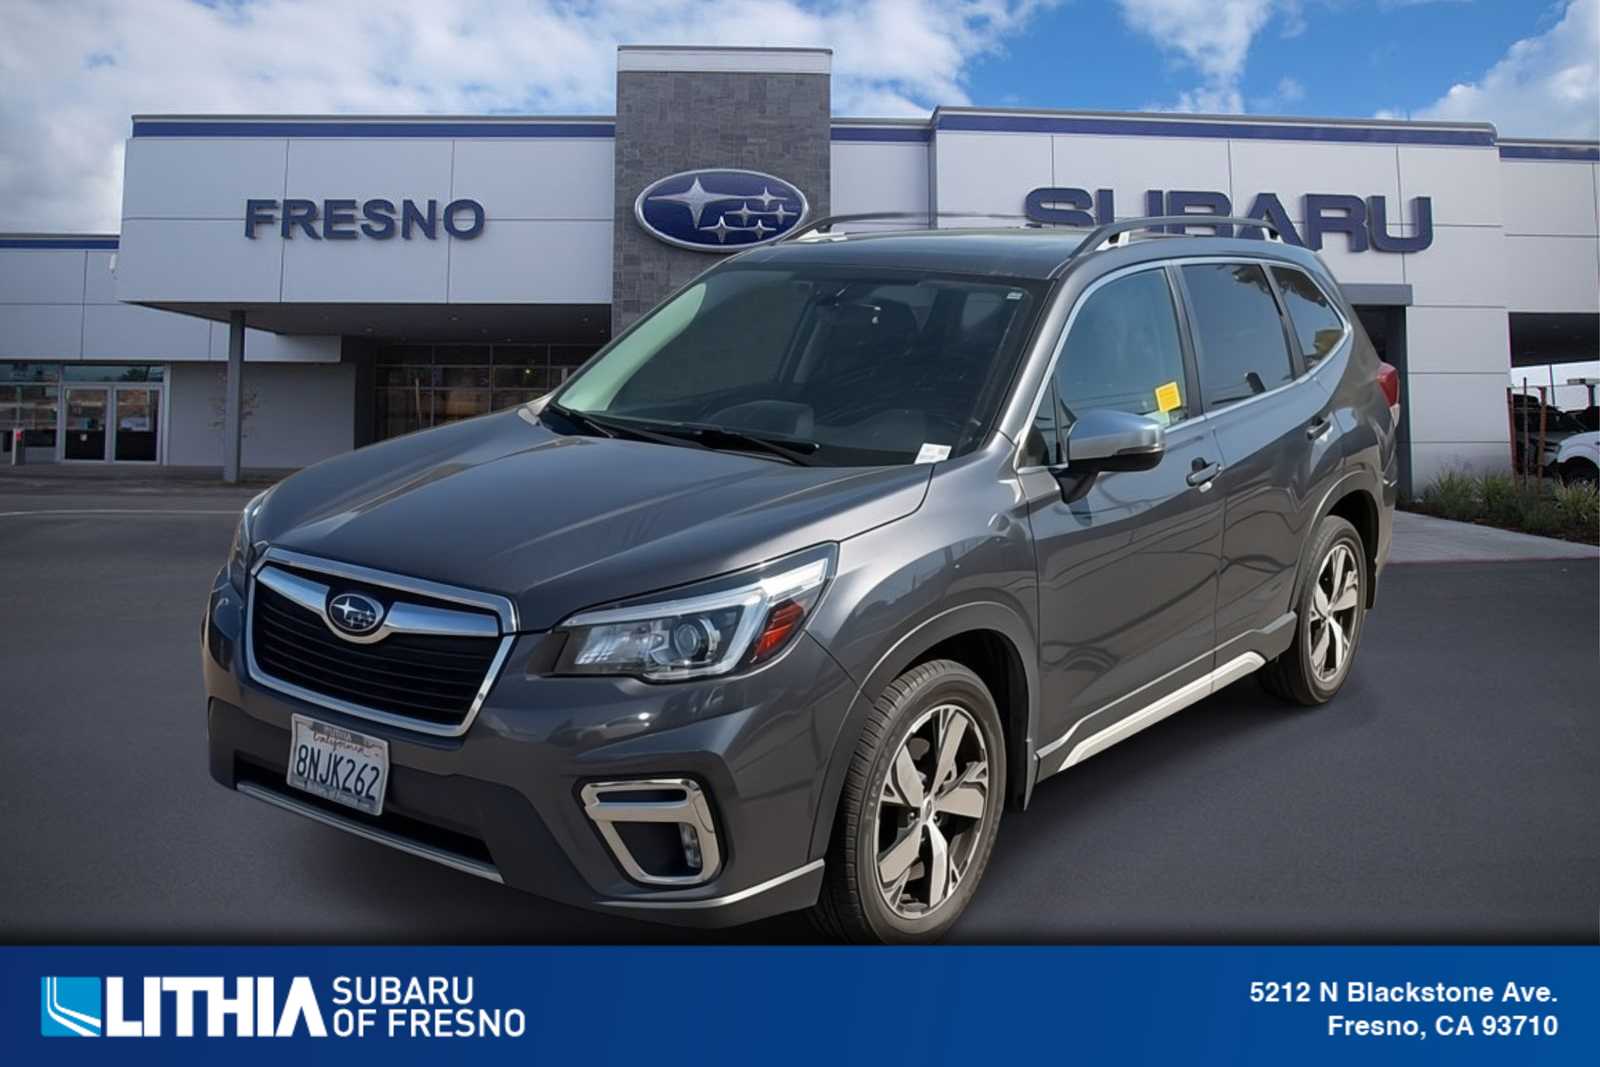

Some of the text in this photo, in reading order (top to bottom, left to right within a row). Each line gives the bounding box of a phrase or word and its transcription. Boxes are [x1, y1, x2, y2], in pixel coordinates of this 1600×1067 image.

[245, 198, 485, 240] FRESNO
[1024, 187, 1433, 253] SUBARU
[296, 744, 380, 801] 8NJK262
